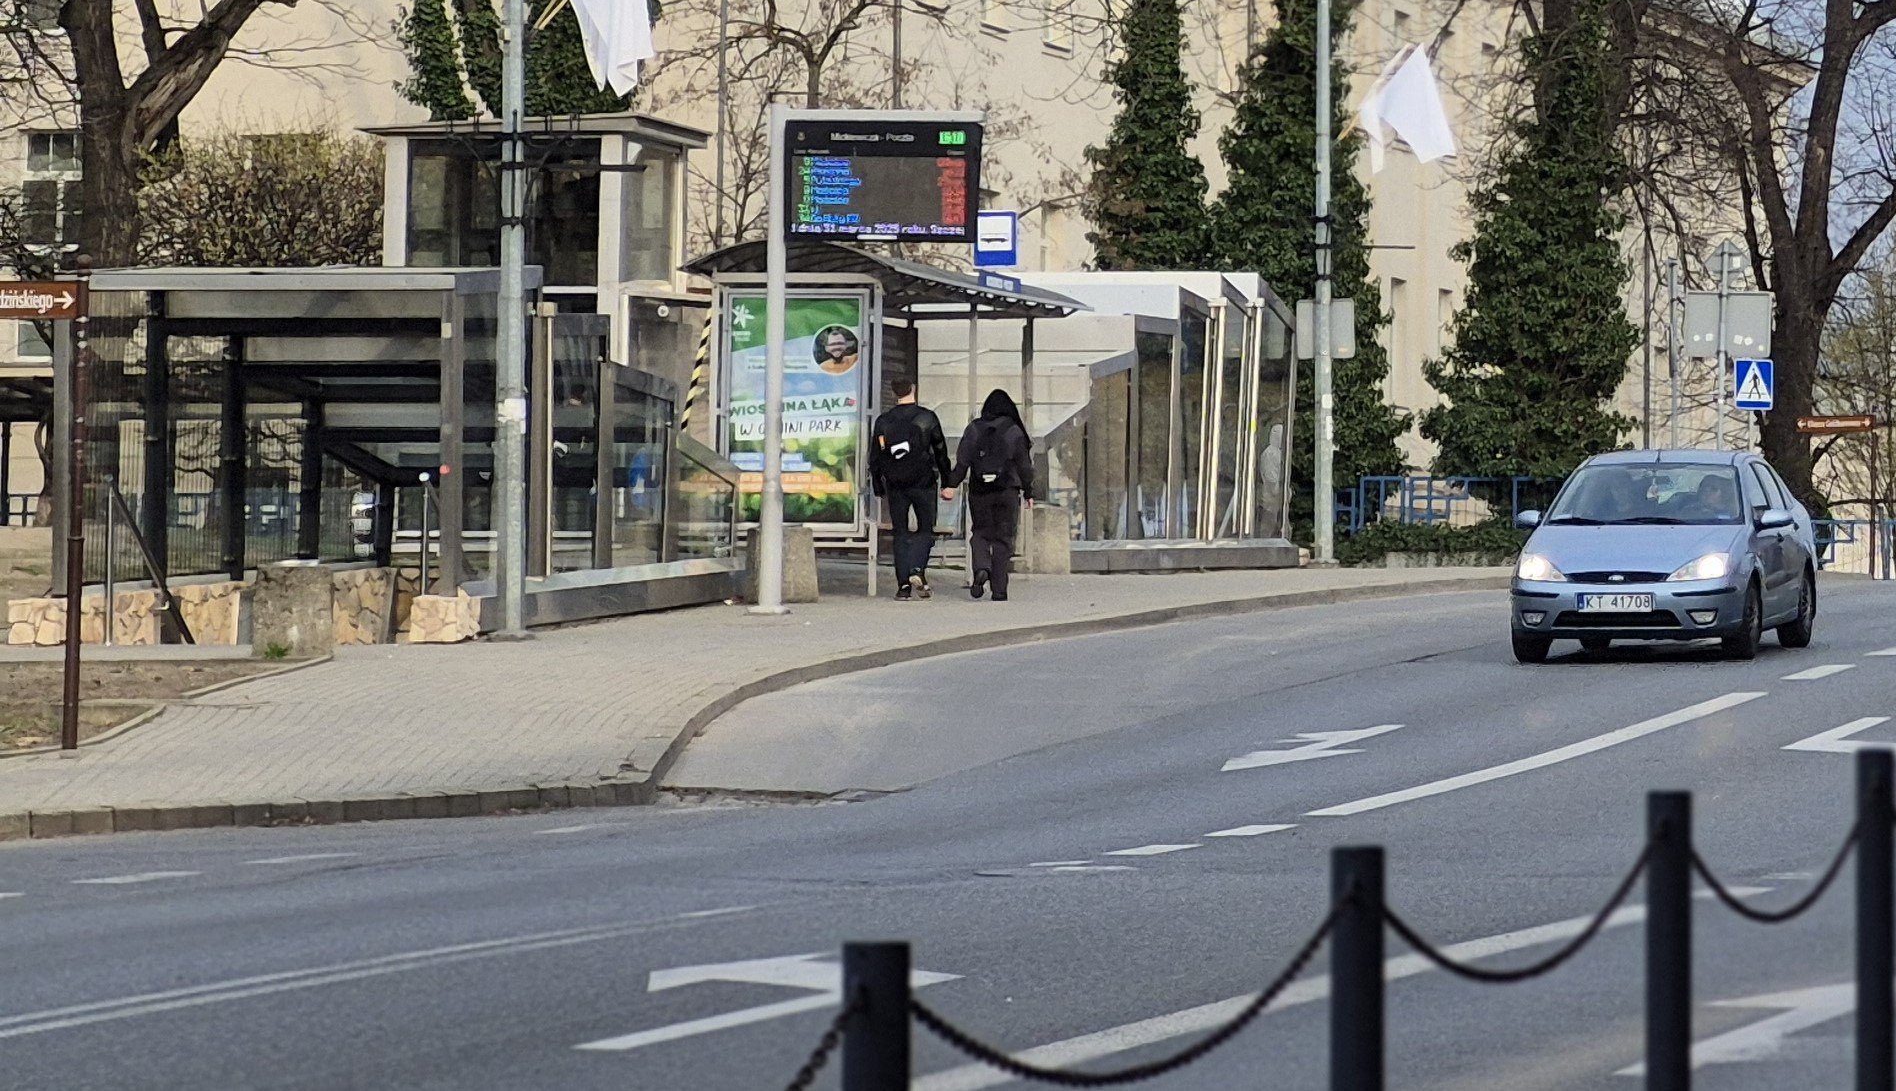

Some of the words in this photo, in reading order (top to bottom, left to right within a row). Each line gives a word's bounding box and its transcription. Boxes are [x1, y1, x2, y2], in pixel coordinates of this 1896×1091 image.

[809, 419, 842, 432] PARK
[1586, 595, 1604, 608] KT
[1611, 595, 1651, 608] 41708
